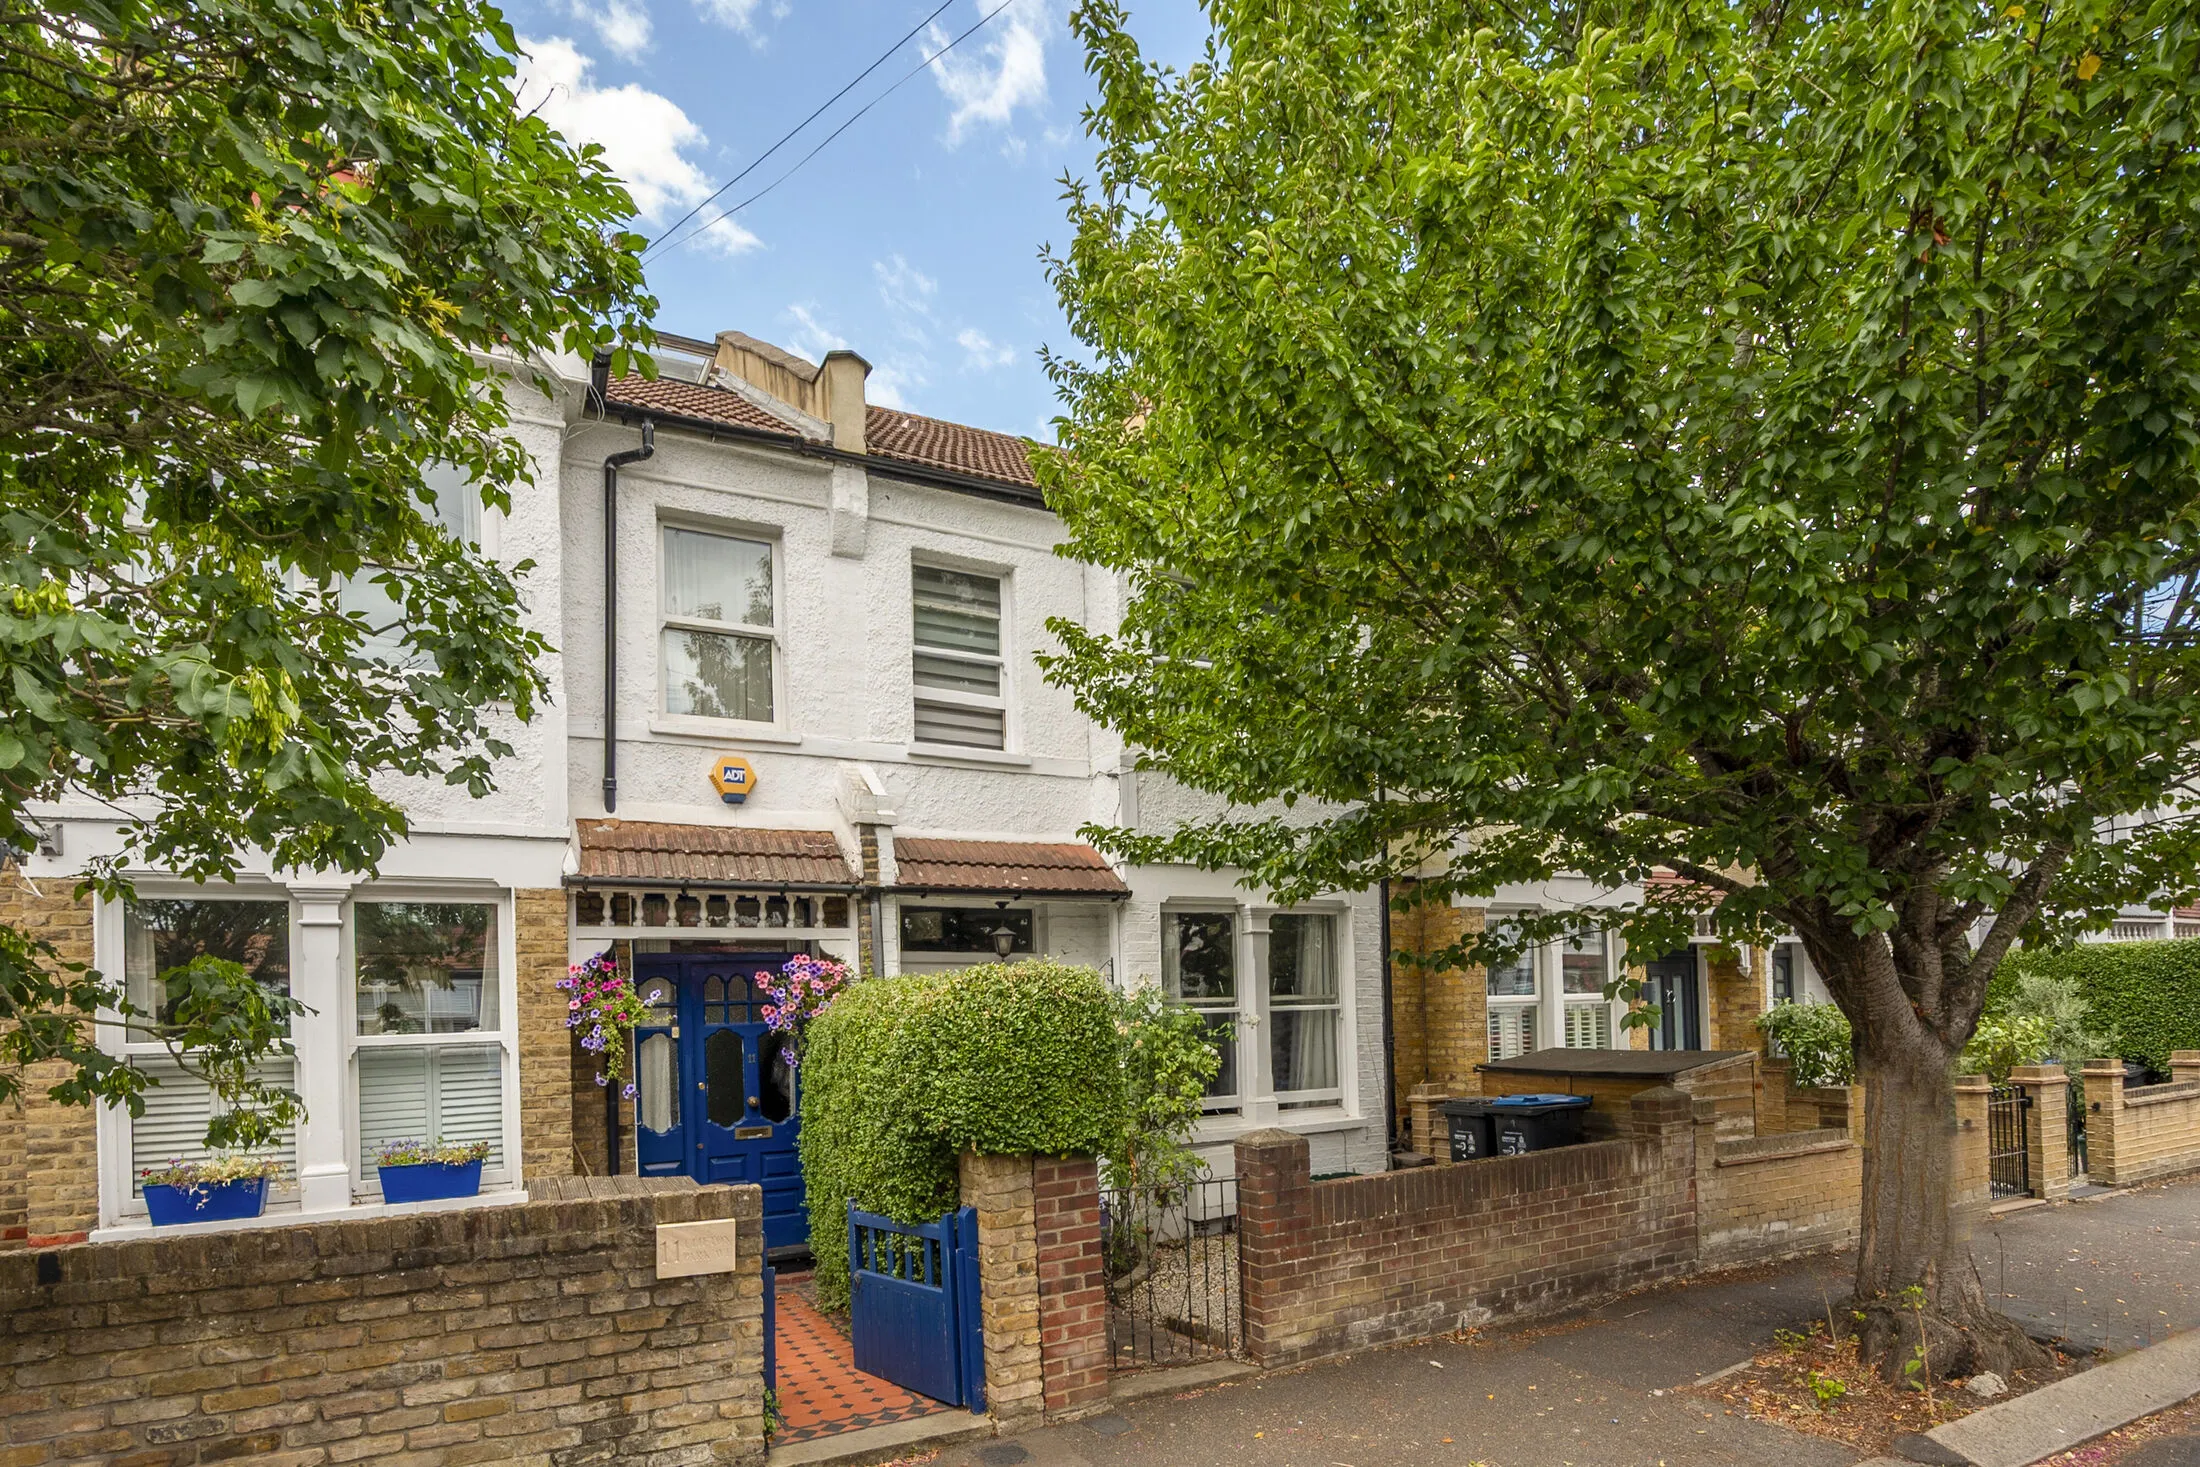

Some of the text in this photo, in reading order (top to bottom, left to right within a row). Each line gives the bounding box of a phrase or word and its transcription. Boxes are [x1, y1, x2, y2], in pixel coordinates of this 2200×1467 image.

[724, 769, 745, 782] ADT
[748, 1054, 756, 1064] 11
[660, 1240, 680, 1266] 11
